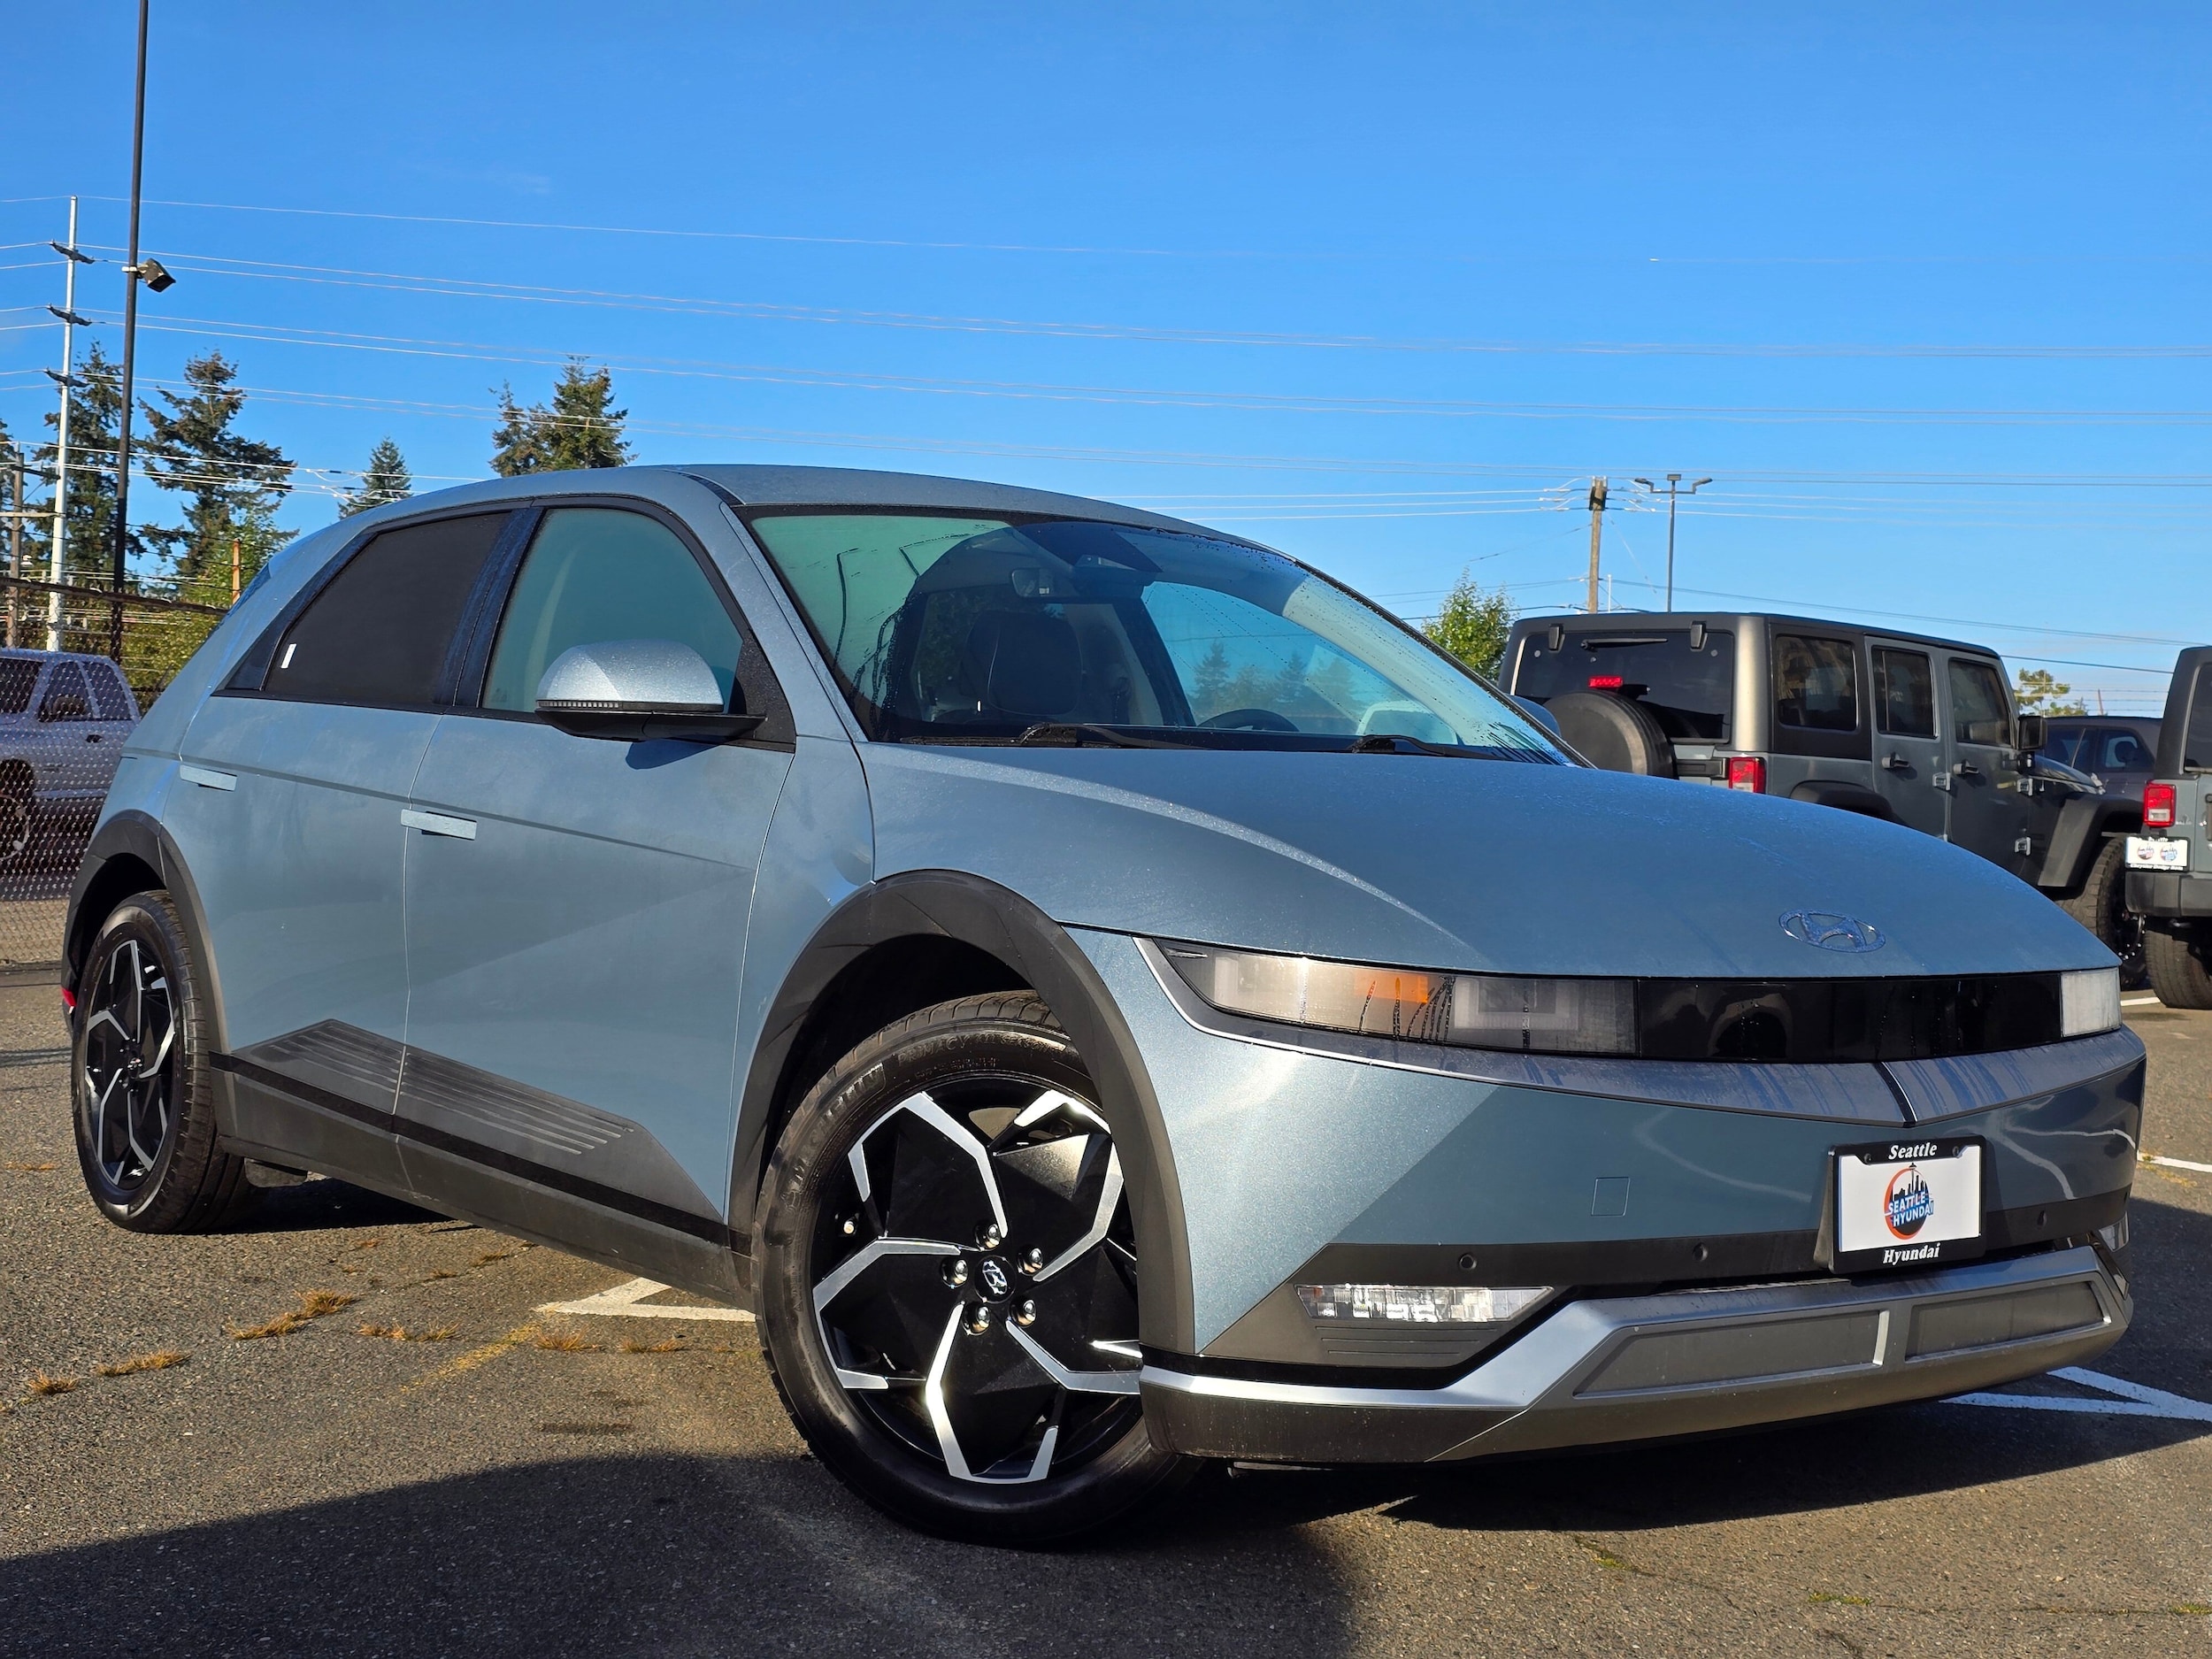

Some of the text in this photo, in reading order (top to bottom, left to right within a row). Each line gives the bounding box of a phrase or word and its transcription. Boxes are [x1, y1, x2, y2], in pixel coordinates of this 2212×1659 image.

[898, 1034, 971, 1066] PRIMACY
[1888, 1142, 1938, 1160] Seattle
[1887, 1192, 1927, 1215] SEATTLE
[1893, 1201, 1935, 1227] HYUNDAI
[1883, 1242, 1940, 1265] Hyundai
